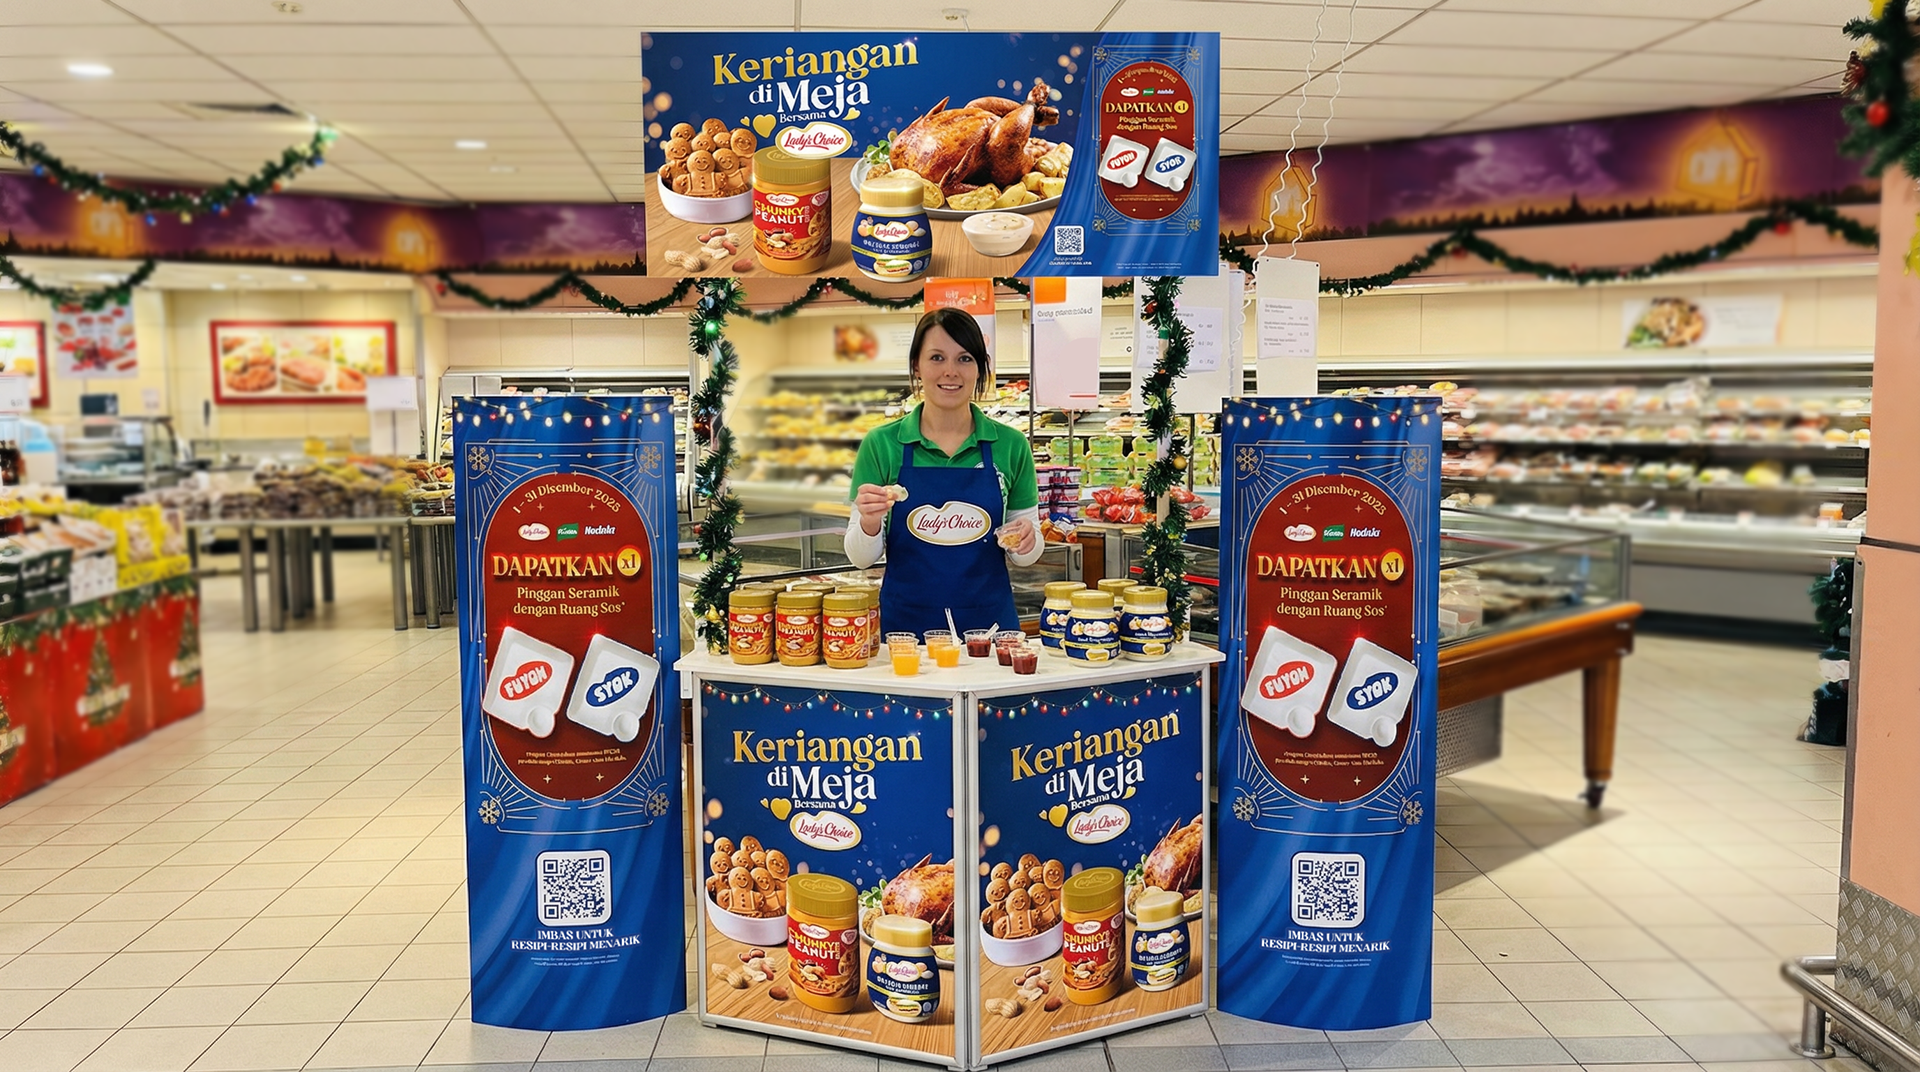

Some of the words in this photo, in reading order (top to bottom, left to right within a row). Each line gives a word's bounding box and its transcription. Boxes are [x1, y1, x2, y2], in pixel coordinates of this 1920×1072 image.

[713, 41, 919, 86] Keriangan
[749, 83, 773, 105] di
[777, 74, 871, 118] Meja
[779, 111, 827, 124] Bersama
[1105, 102, 1173, 114] DAPATKAN
[917, 513, 948, 535] Lady's
[948, 514, 983, 530] Choice
[492, 555, 614, 577] DAPATKAN
[1257, 555, 1378, 578] DAPATKAN
[516, 586, 566, 602] Pinggan
[568, 585, 620, 599] Seramik
[1280, 586, 1330, 603] Pinggan
[1331, 588, 1383, 601] Seramik
[513, 603, 557, 617] dengan
[559, 602, 599, 618] Ruang
[1276, 602, 1321, 618] dengan
[1323, 604, 1363, 620] Ruang
[593, 671, 633, 703] SYOK
[1354, 676, 1393, 706] SYOK
[732, 729, 923, 773] Keriangan
[1010, 711, 1181, 782] Keriangan
[767, 766, 789, 788] di
[790, 765, 877, 810] Meja
[1045, 772, 1065, 796] di
[1066, 754, 1145, 802] Meja
[1071, 793, 1110, 811] Bersama
[511, 940, 588, 951] RESIPI-RESIPI
[589, 935, 641, 950] MENARIK
[538, 930, 574, 940] IMBAS
[576, 928, 614, 940] UNTUK
[1288, 930, 1324, 941] IMBAS
[1326, 932, 1364, 942] UNTUK
[1261, 938, 1337, 953] RESIPI-RESIPI
[1339, 941, 1390, 953] MENARIK
